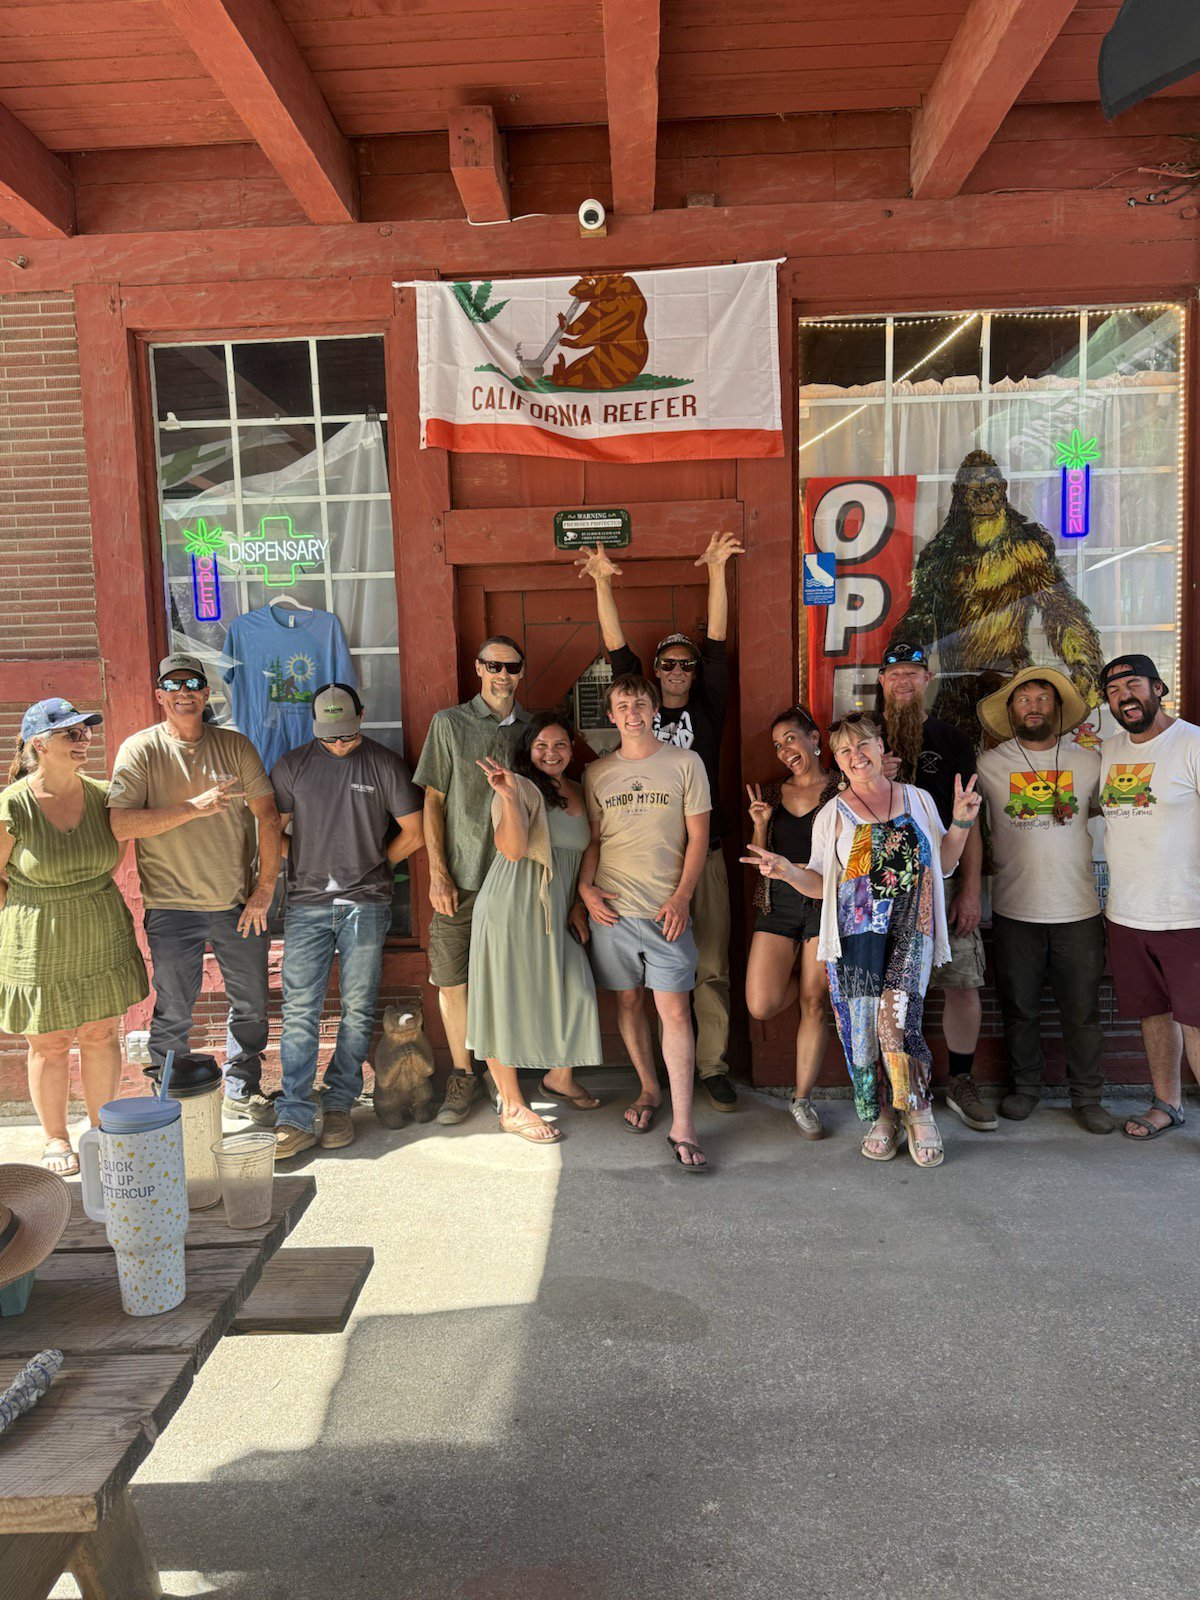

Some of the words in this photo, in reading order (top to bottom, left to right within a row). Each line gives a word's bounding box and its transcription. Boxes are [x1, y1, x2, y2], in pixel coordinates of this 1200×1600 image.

[472, 386, 592, 427] CALIFORNIA
[603, 394, 697, 424] REEFER
[1068, 470, 1084, 534] OPEN
[229, 539, 329, 563] DISPENSARY
[198, 557, 215, 618] OPEN
[813, 480, 896, 723] OPE
[605, 793, 634, 809] MENDO
[637, 793, 670, 805] MYSTIC
[1103, 808, 1130, 819] appyDay
[103, 1159, 134, 1173] SUCK
[117, 1175, 134, 1186] UP
[103, 1185, 156, 1199] TTERCUP
